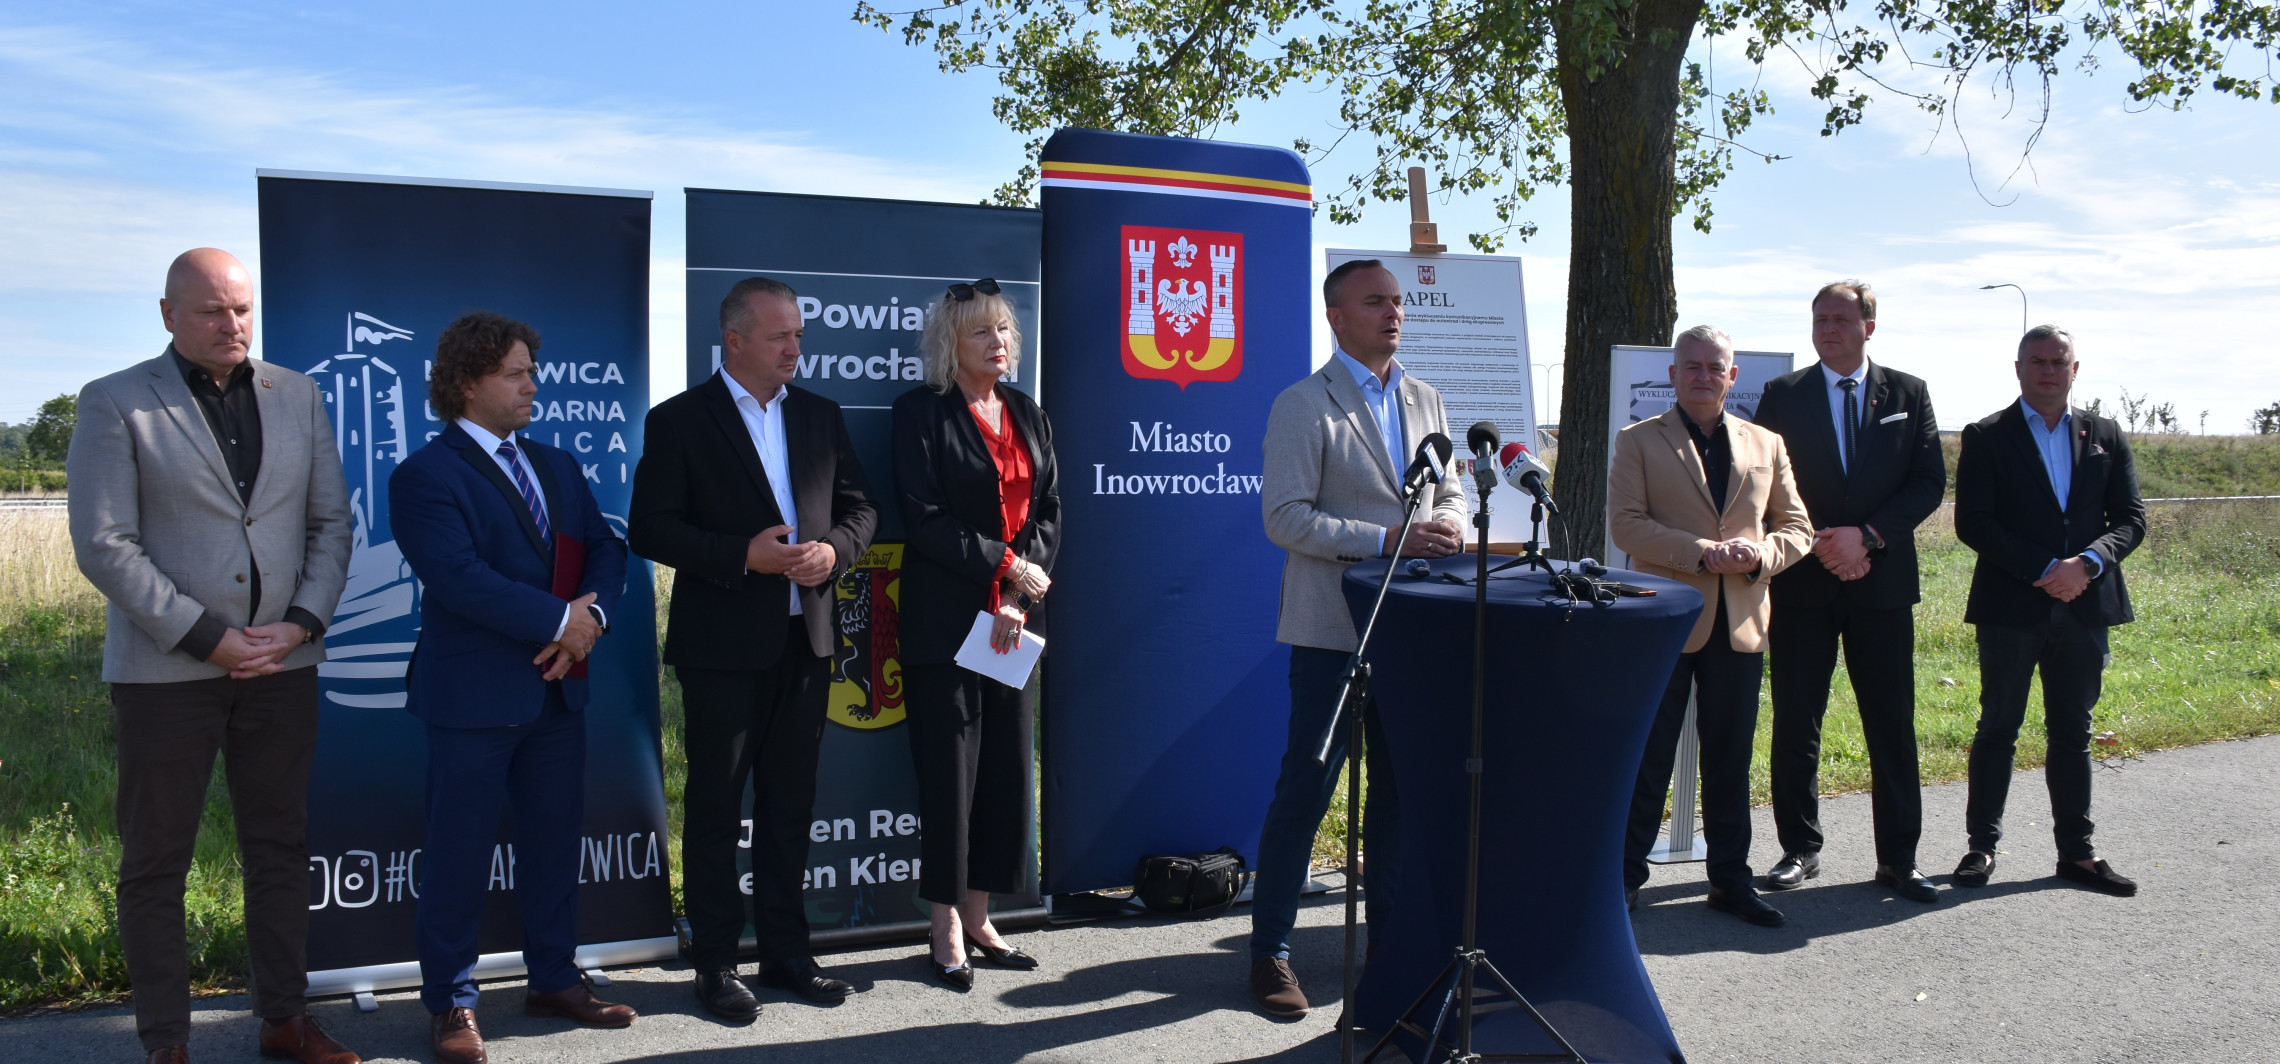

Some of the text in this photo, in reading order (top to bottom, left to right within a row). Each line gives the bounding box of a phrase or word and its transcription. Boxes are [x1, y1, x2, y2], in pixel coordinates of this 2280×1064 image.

[1403, 291, 1455, 307] APEL
[1129, 421, 1231, 453] Miasto
[1093, 462, 1263, 495] Inowrocław
